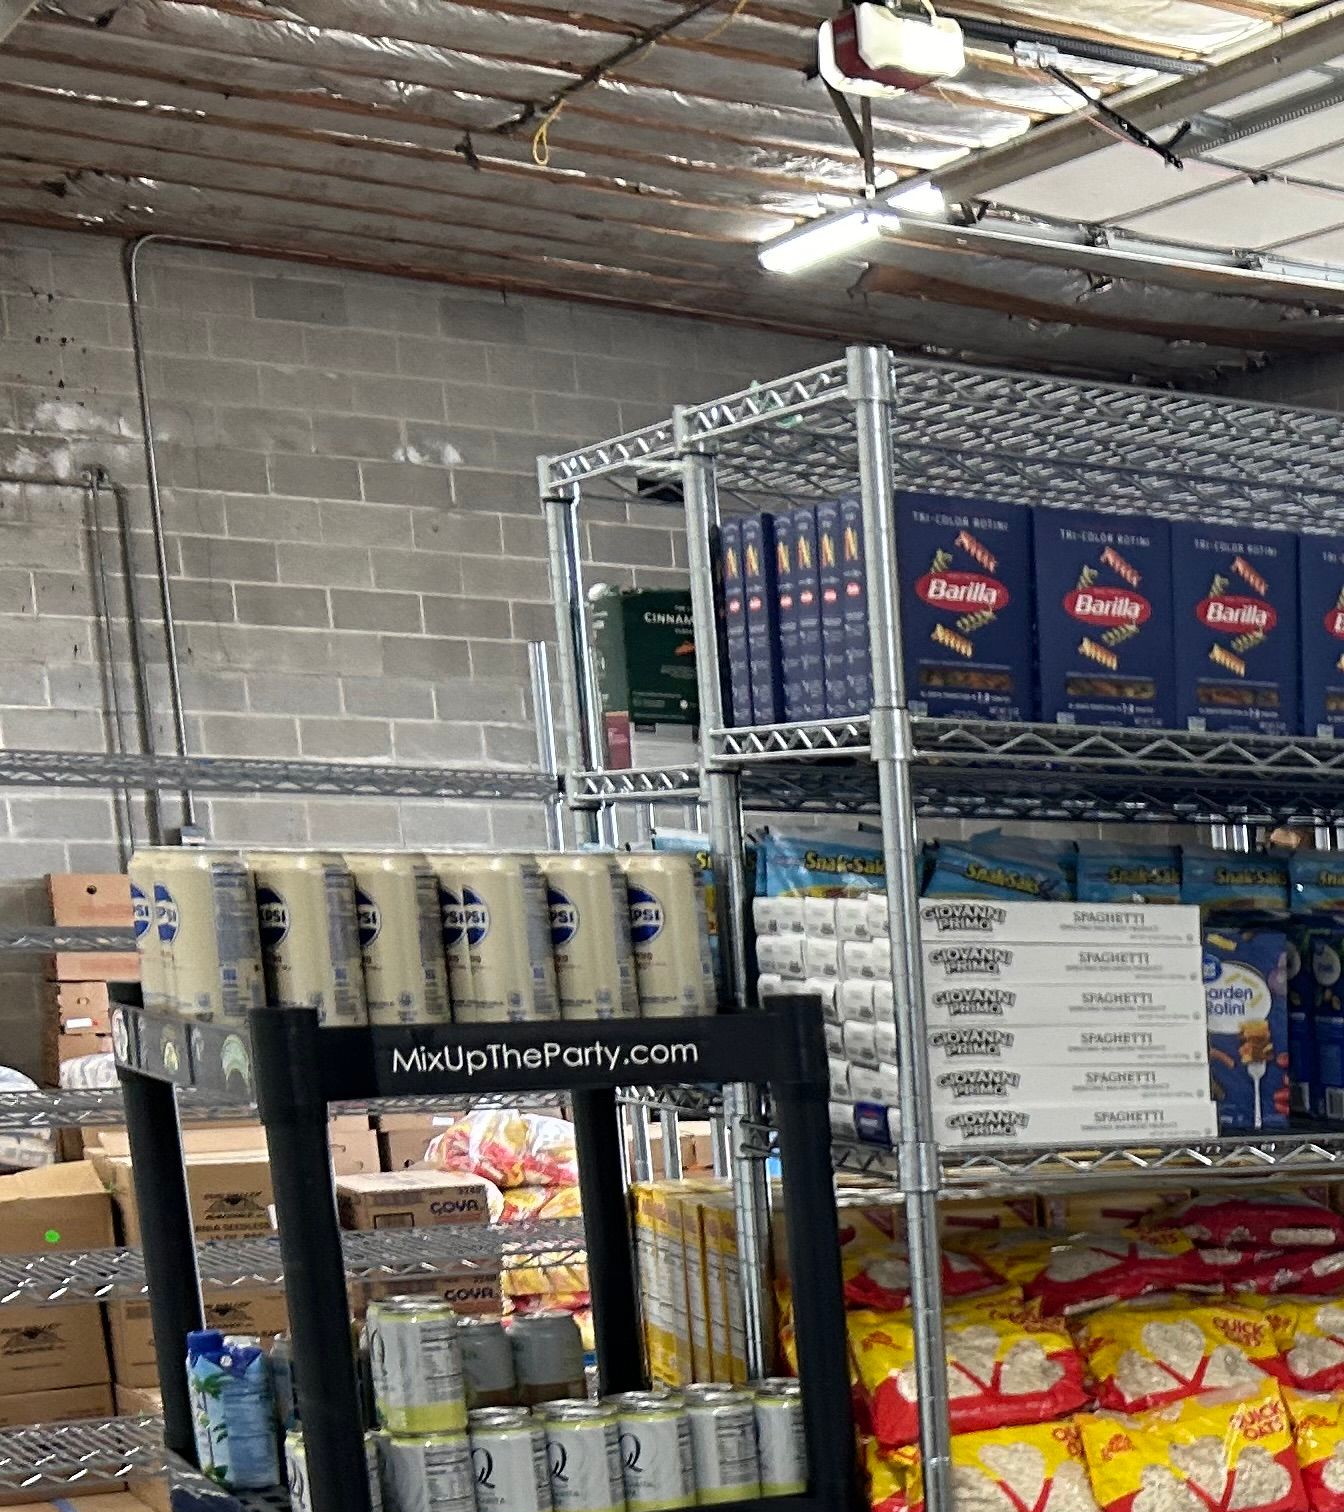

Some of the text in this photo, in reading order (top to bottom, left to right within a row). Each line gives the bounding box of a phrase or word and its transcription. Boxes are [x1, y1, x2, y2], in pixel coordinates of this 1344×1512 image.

[928, 578, 997, 605] Barilla
[1075, 594, 1141, 619] Barilla
[1206, 602, 1267, 627] Barilla
[643, 611, 694, 625] CINNAM
[804, 850, 885, 875] Snak-Sak
[259, 907, 286, 923] PSI
[549, 909, 575, 924] PSI
[630, 908, 661, 922] PSI
[920, 903, 1007, 924] GIOVANNI
[1073, 911, 1145, 924] SPAGHETTI
[928, 947, 1014, 967] GIOVANNI
[1078, 951, 1150, 964] SPAGHETTI
[931, 988, 1017, 1008] GIOVANNI
[1081, 992, 1153, 1004] SPAGHETTI
[1205, 985, 1254, 1001] arden
[928, 1029, 1015, 1048] GIOVANNI
[1080, 1032, 1153, 1044] SPAGHETTI
[391, 1041, 698, 1076] MixUpTheParty.com
[936, 1069, 1021, 1089] GIOVANNI
[1084, 1071, 1156, 1083] SPAGHETTI
[945, 1110, 1031, 1129] GIOVANNI
[1093, 1110, 1165, 1122] SPAGHETTI
[430, 1199, 480, 1214] GOYA
[443, 1286, 495, 1302] GOYA
